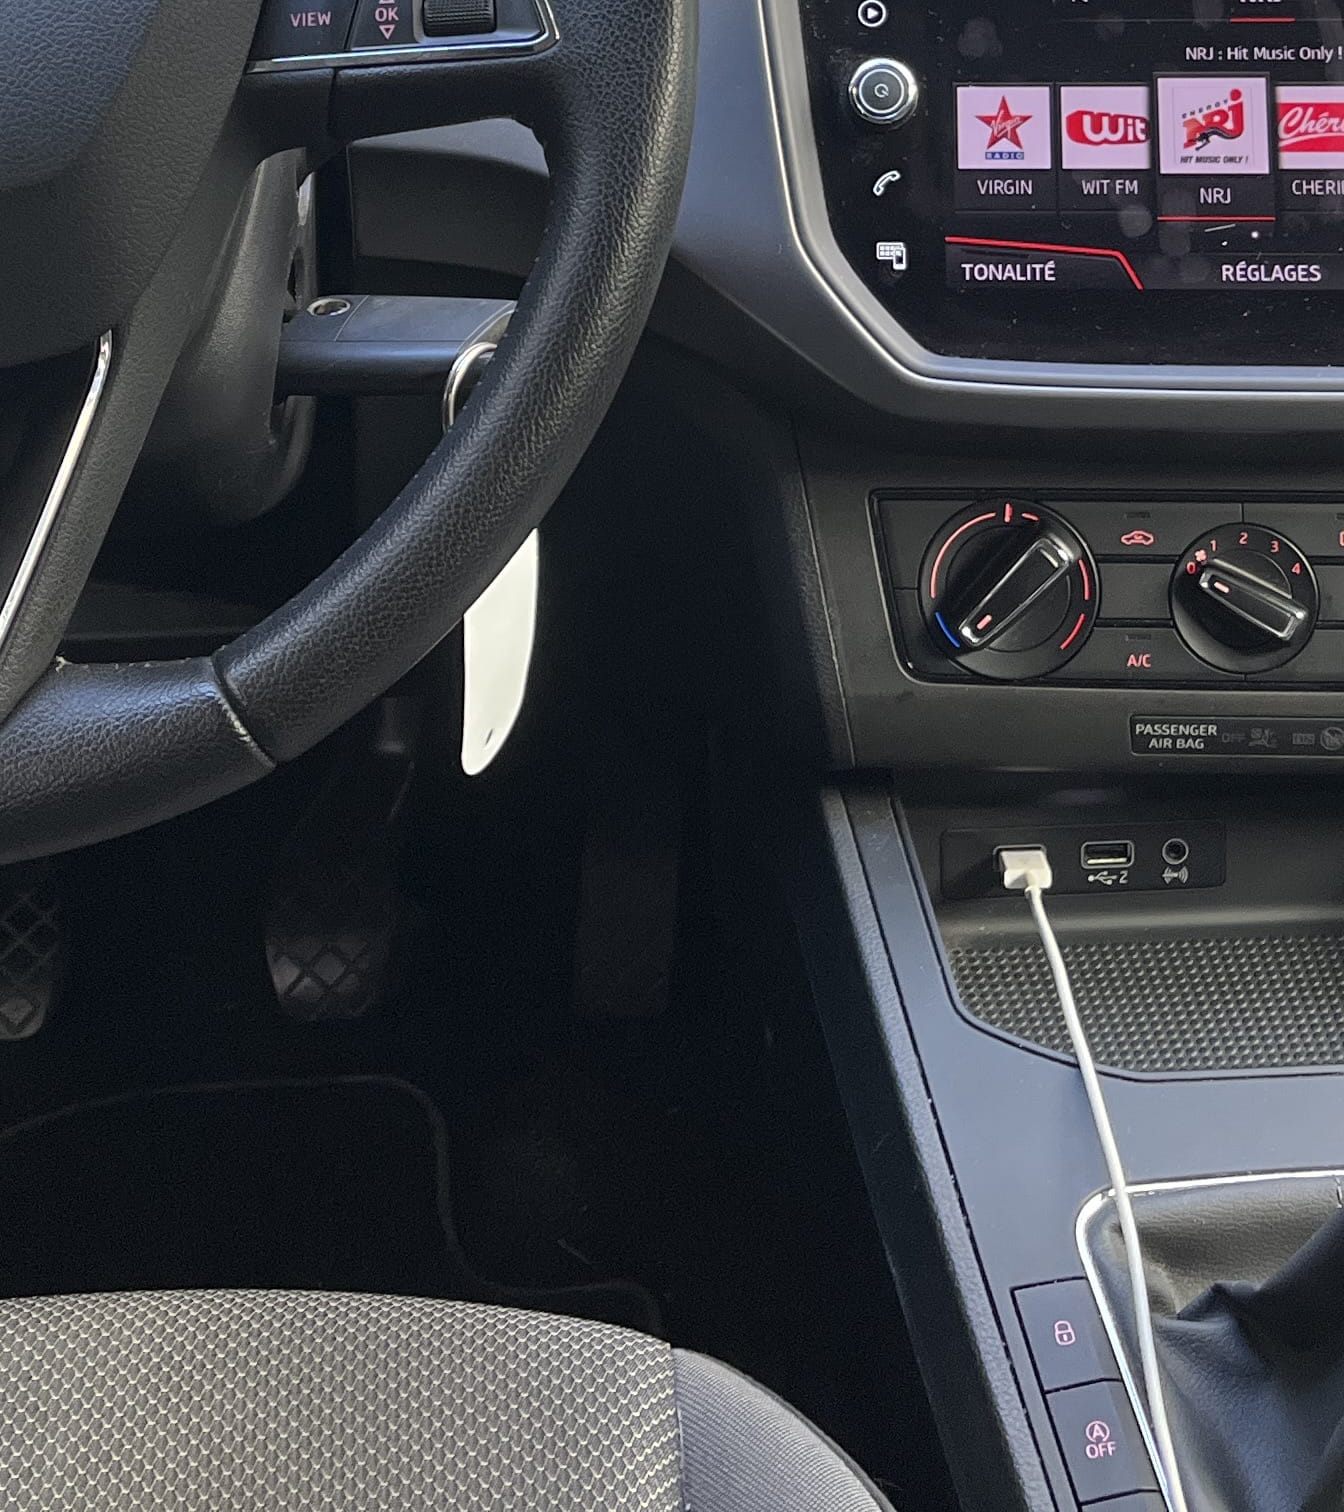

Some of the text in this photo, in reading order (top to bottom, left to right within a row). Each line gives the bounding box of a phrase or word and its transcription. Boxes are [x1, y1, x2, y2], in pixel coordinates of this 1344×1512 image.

[290, 11, 332, 27] VIEW
[375, 7, 399, 22] OK
[1185, 46, 1214, 61] NRJ
[1227, 45, 1249, 61] Hit
[1253, 45, 1296, 61] Music
[1299, 45, 1334, 64] Only
[1082, 113, 1148, 142] Wit
[977, 179, 1033, 195] VIRGIN
[1081, 179, 1138, 195] WIT FM
[1199, 188, 1231, 204] NRJ
[961, 260, 1056, 283] TONALITÉ
[1220, 260, 1322, 283] RÉGLAGES
[1239, 532, 1249, 545] 2
[1270, 540, 1280, 553] 3
[1291, 563, 1302, 575] 4
[1127, 653, 1152, 667] A/C
[1135, 722, 1218, 736] PASSENGER
[1148, 737, 1205, 750] AIR BAG
[1118, 870, 1129, 884] 2
[1085, 1441, 1117, 1459] OFF
